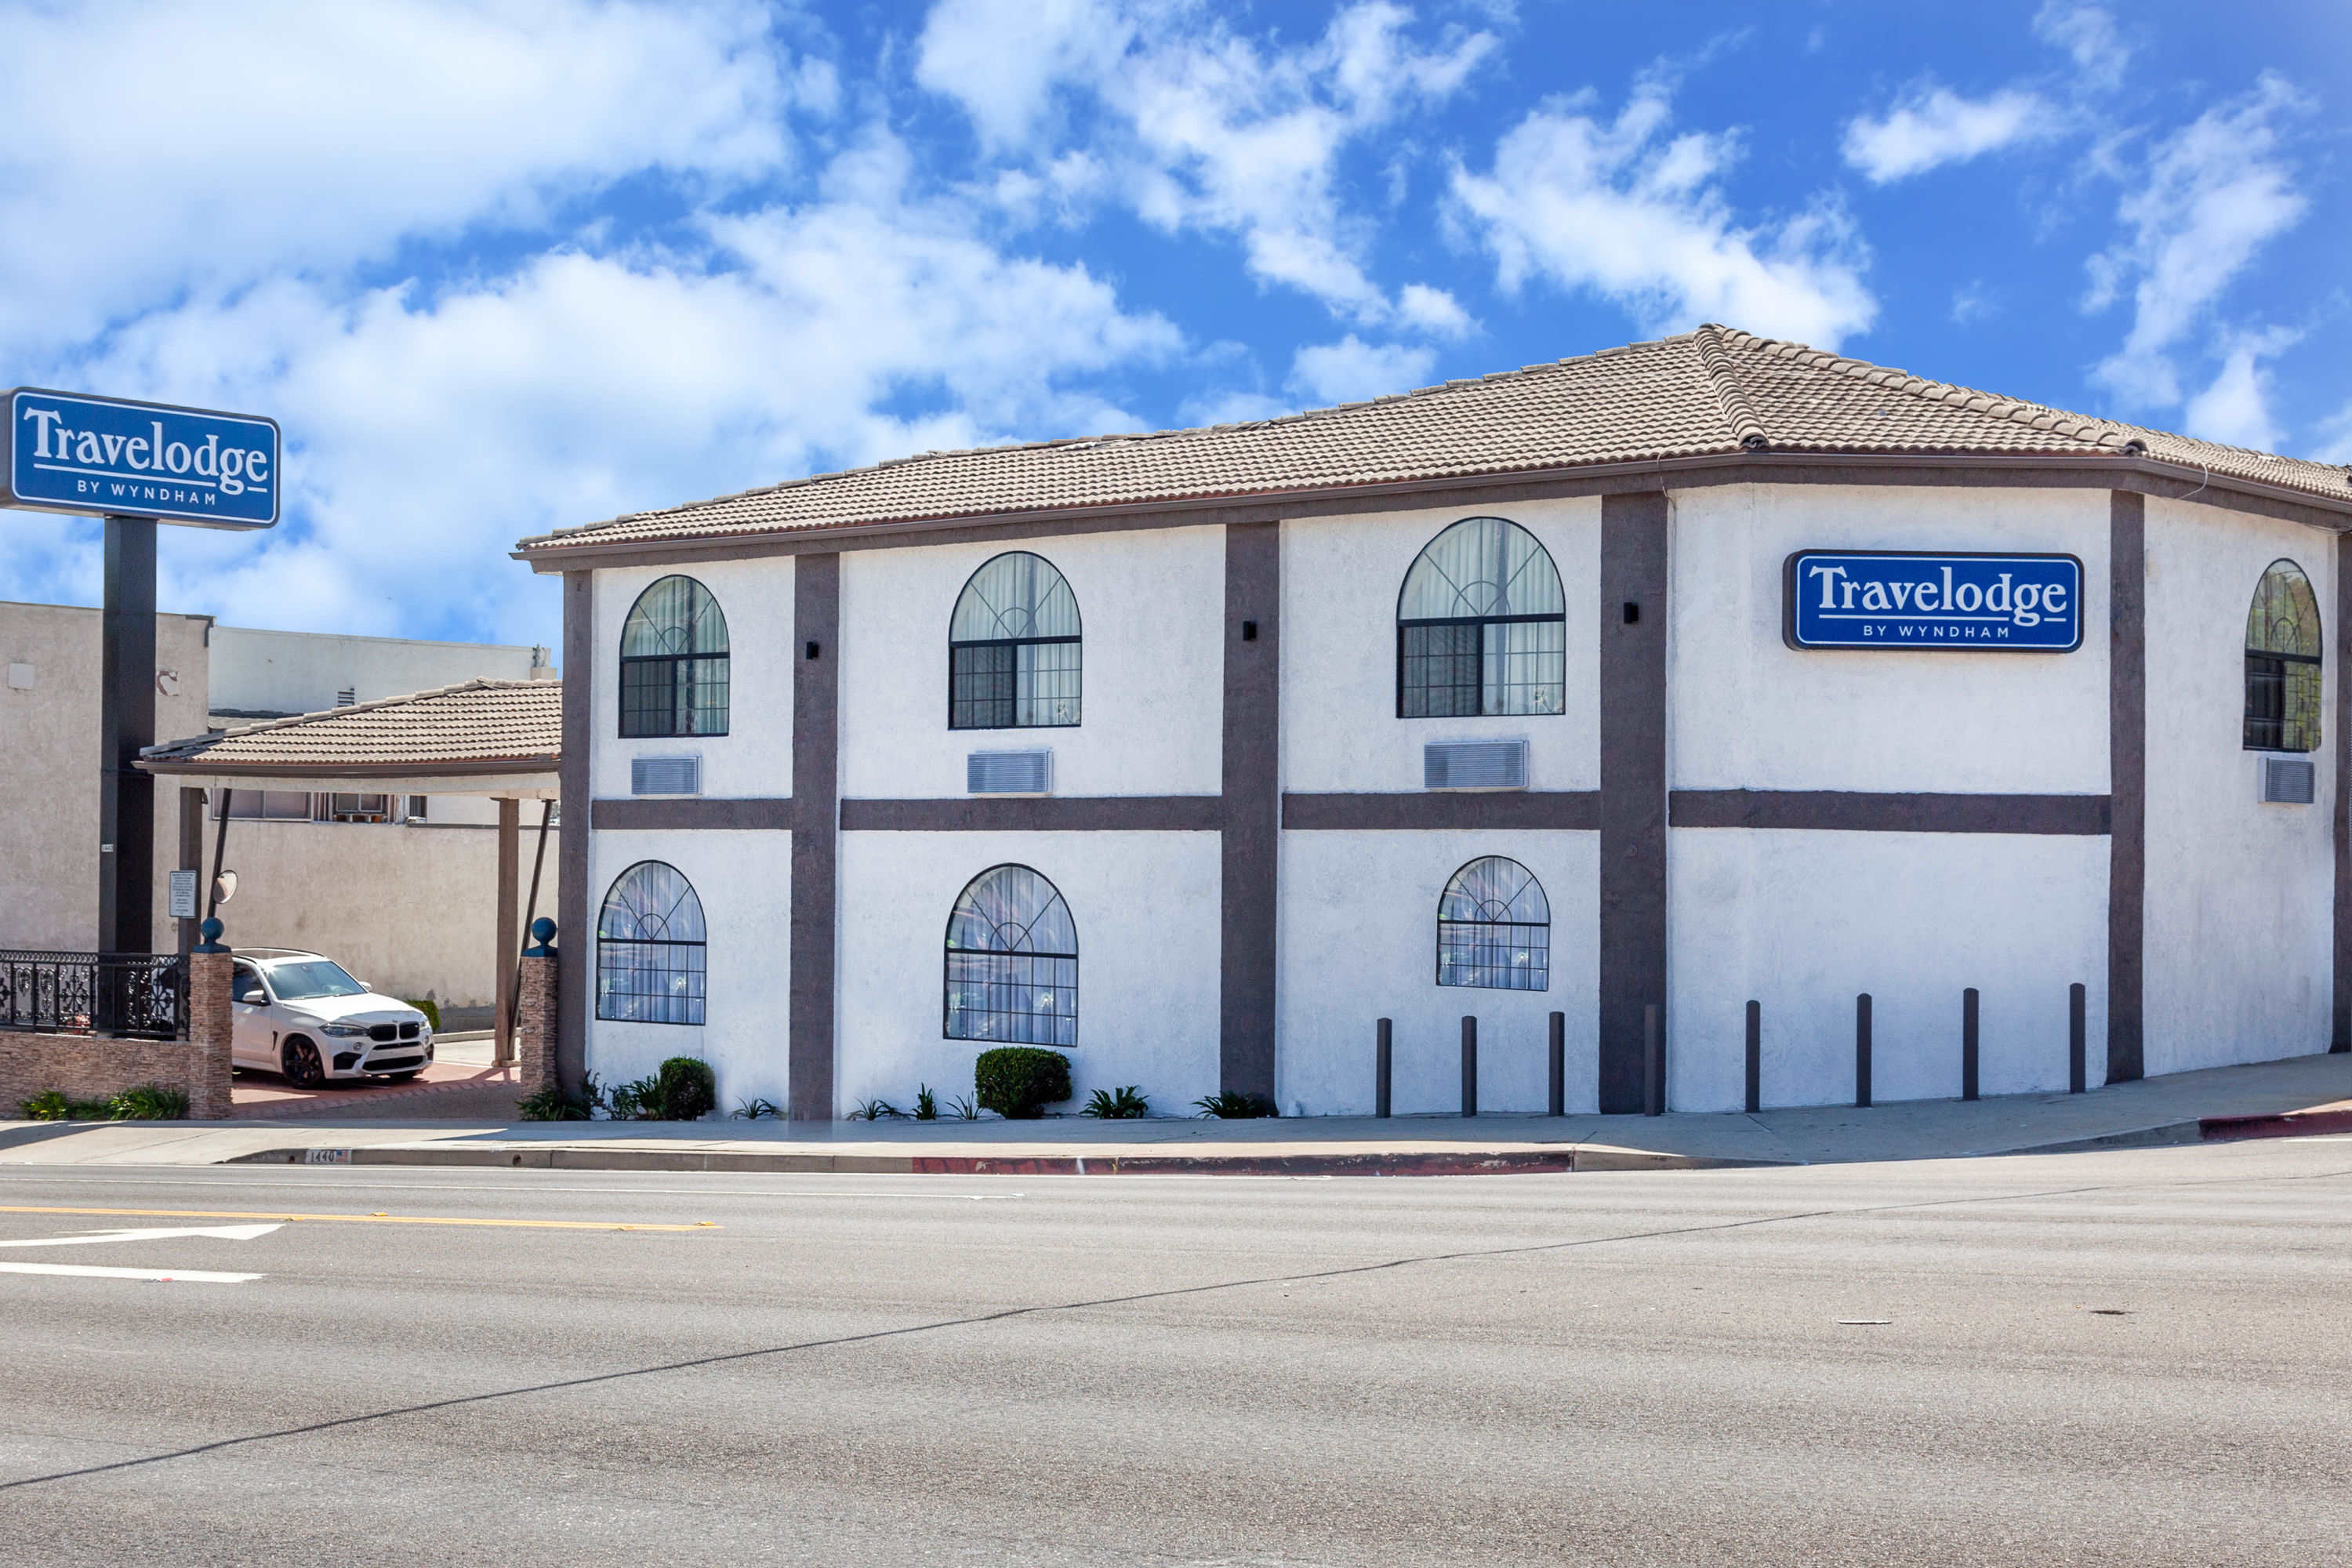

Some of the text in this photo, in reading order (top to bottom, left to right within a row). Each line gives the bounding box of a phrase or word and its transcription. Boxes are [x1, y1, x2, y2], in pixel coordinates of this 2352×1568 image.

[24, 407, 267, 495] Travelodge
[78, 480, 216, 505] BY WYNDHAM
[1809, 565, 2067, 626] Travelodge
[1864, 625, 2009, 638] BY WYNDHAM
[311, 1151, 334, 1163] 1440
